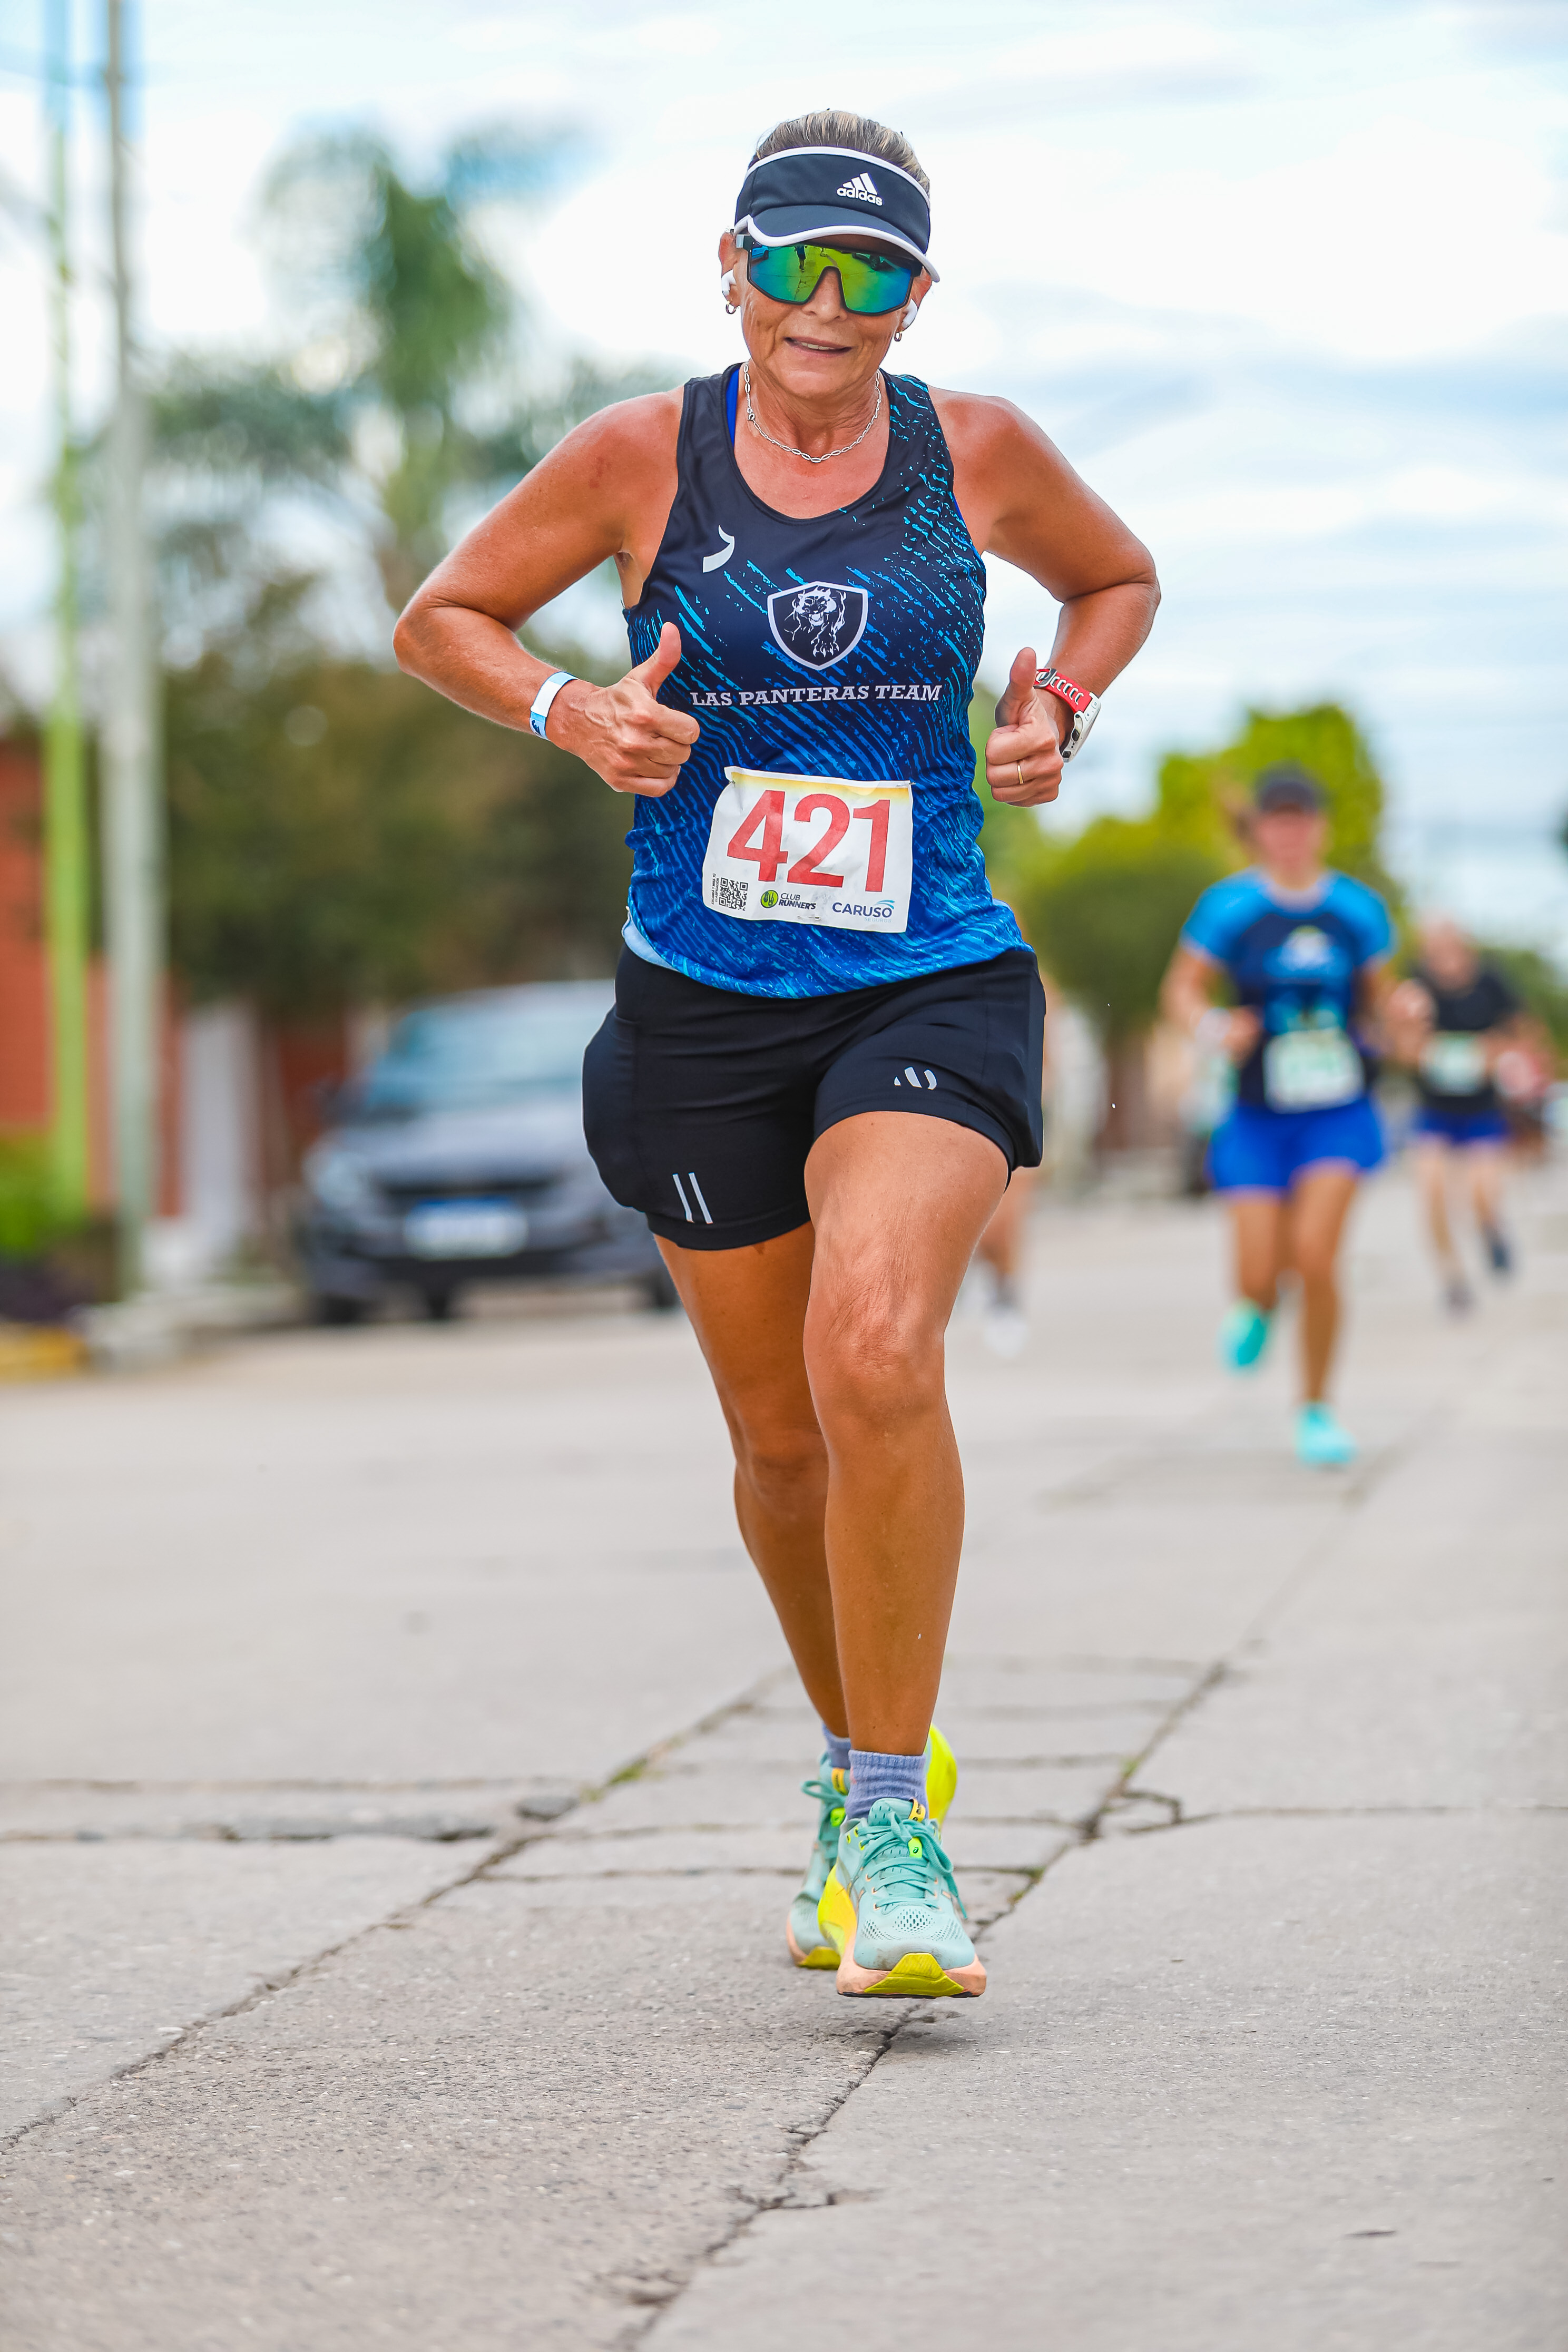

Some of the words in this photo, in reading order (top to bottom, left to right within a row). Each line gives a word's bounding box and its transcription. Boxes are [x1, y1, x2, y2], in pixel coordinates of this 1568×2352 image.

[837, 187, 883, 206] adidas
[690, 692, 732, 706] LAS
[739, 686, 869, 705] PANTERAS
[875, 685, 942, 701] TEAM
[727, 789, 890, 893] 421
[780, 893, 800, 901] CLUB
[832, 902, 892, 918] CARUSO
